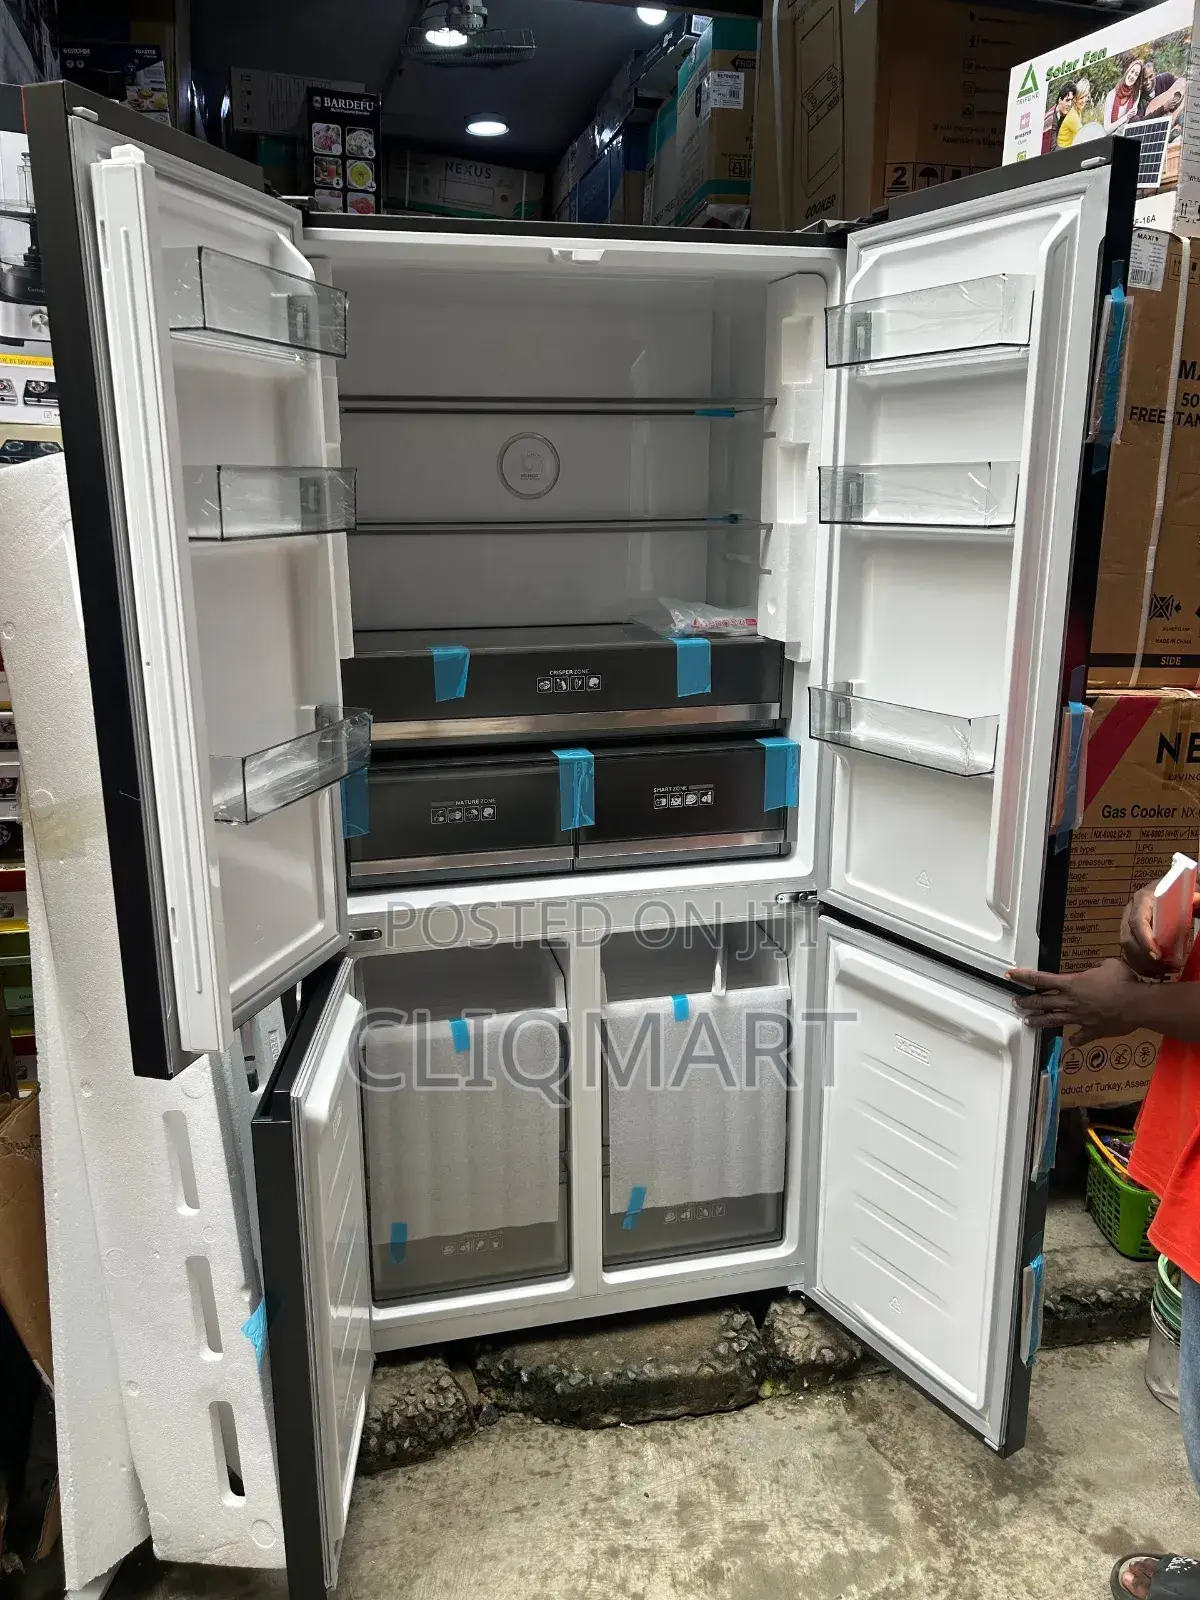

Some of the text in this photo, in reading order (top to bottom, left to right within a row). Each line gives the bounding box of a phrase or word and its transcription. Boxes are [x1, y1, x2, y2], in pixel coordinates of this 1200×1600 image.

[1045, 47, 1108, 81] Solar Fan
[324, 97, 374, 111] BARDEFU
[1016, 92, 1039, 105] TRIFONE
[1014, 129, 1032, 140] WHISPER
[445, 161, 492, 179] NEXUS
[892, 166, 907, 186] 2
[805, 194, 837, 219] COOKER
[1137, 233, 1154, 241] MAXI
[1178, 360, 1200, 380] M
[1160, 656, 1182, 665] SIDE
[1156, 732, 1200, 764] NE
[1101, 804, 1127, 819] Gas
[1130, 804, 1178, 819] Cooker
[1071, 832, 1088, 840] odel:
[1079, 845, 1097, 854] type:
[1138, 843, 1154, 851] LPG
[1068, 871, 1088, 881] ltage:
[1068, 885, 1089, 893] plate:
[1079, 898, 1102, 907] power
[1070, 910, 1086, 918] size:
[1061, 1086, 1084, 1095] oduct
[1086, 1084, 1094, 1092] of
[1094, 1082, 1123, 1091] Turkey,
